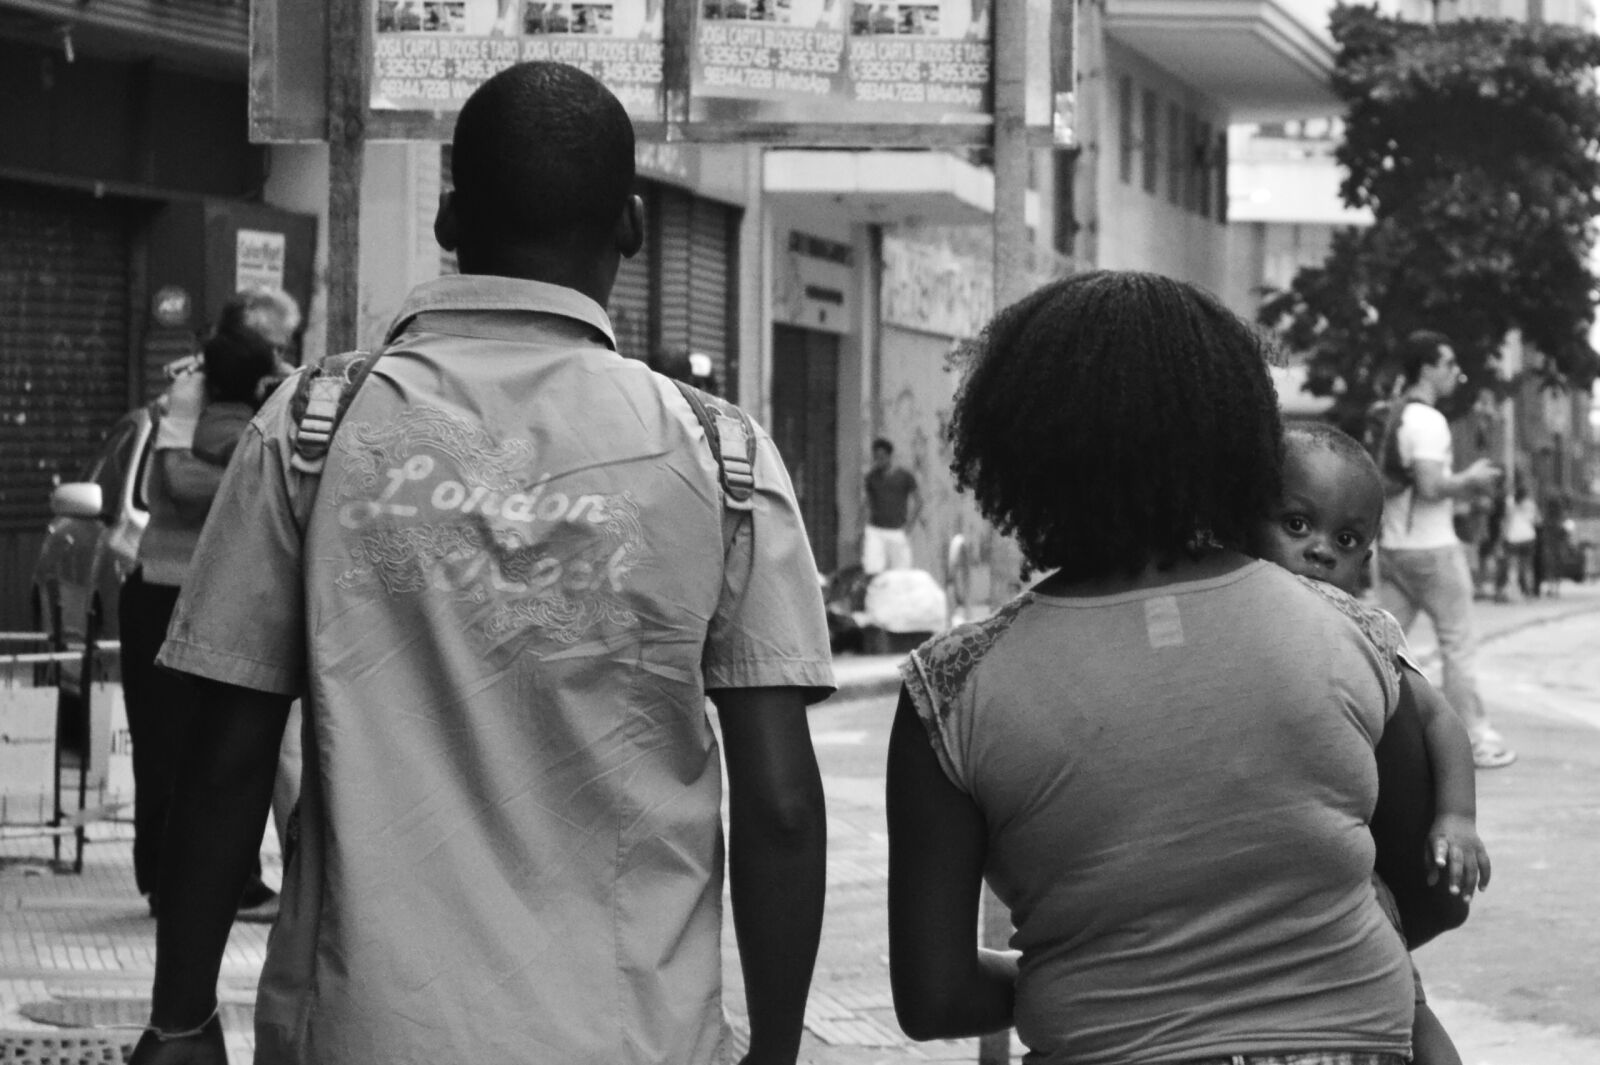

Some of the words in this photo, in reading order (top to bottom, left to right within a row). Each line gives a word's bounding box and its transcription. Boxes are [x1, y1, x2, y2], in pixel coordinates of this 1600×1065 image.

[374, 39, 402, 59] JOGA
[402, 39, 437, 59] CARTA
[479, 40, 489, 60] E
[699, 25, 727, 46] JOGA
[727, 26, 762, 48] CARTA
[805, 31, 815, 52] E
[518, 40, 549, 61] JOGA
[550, 40, 585, 61] CARTA
[627, 41, 638, 62] E
[848, 40, 876, 61] JOGA
[877, 41, 911, 61] CARTA
[953, 43, 963, 62] E
[339, 454, 613, 529] London
